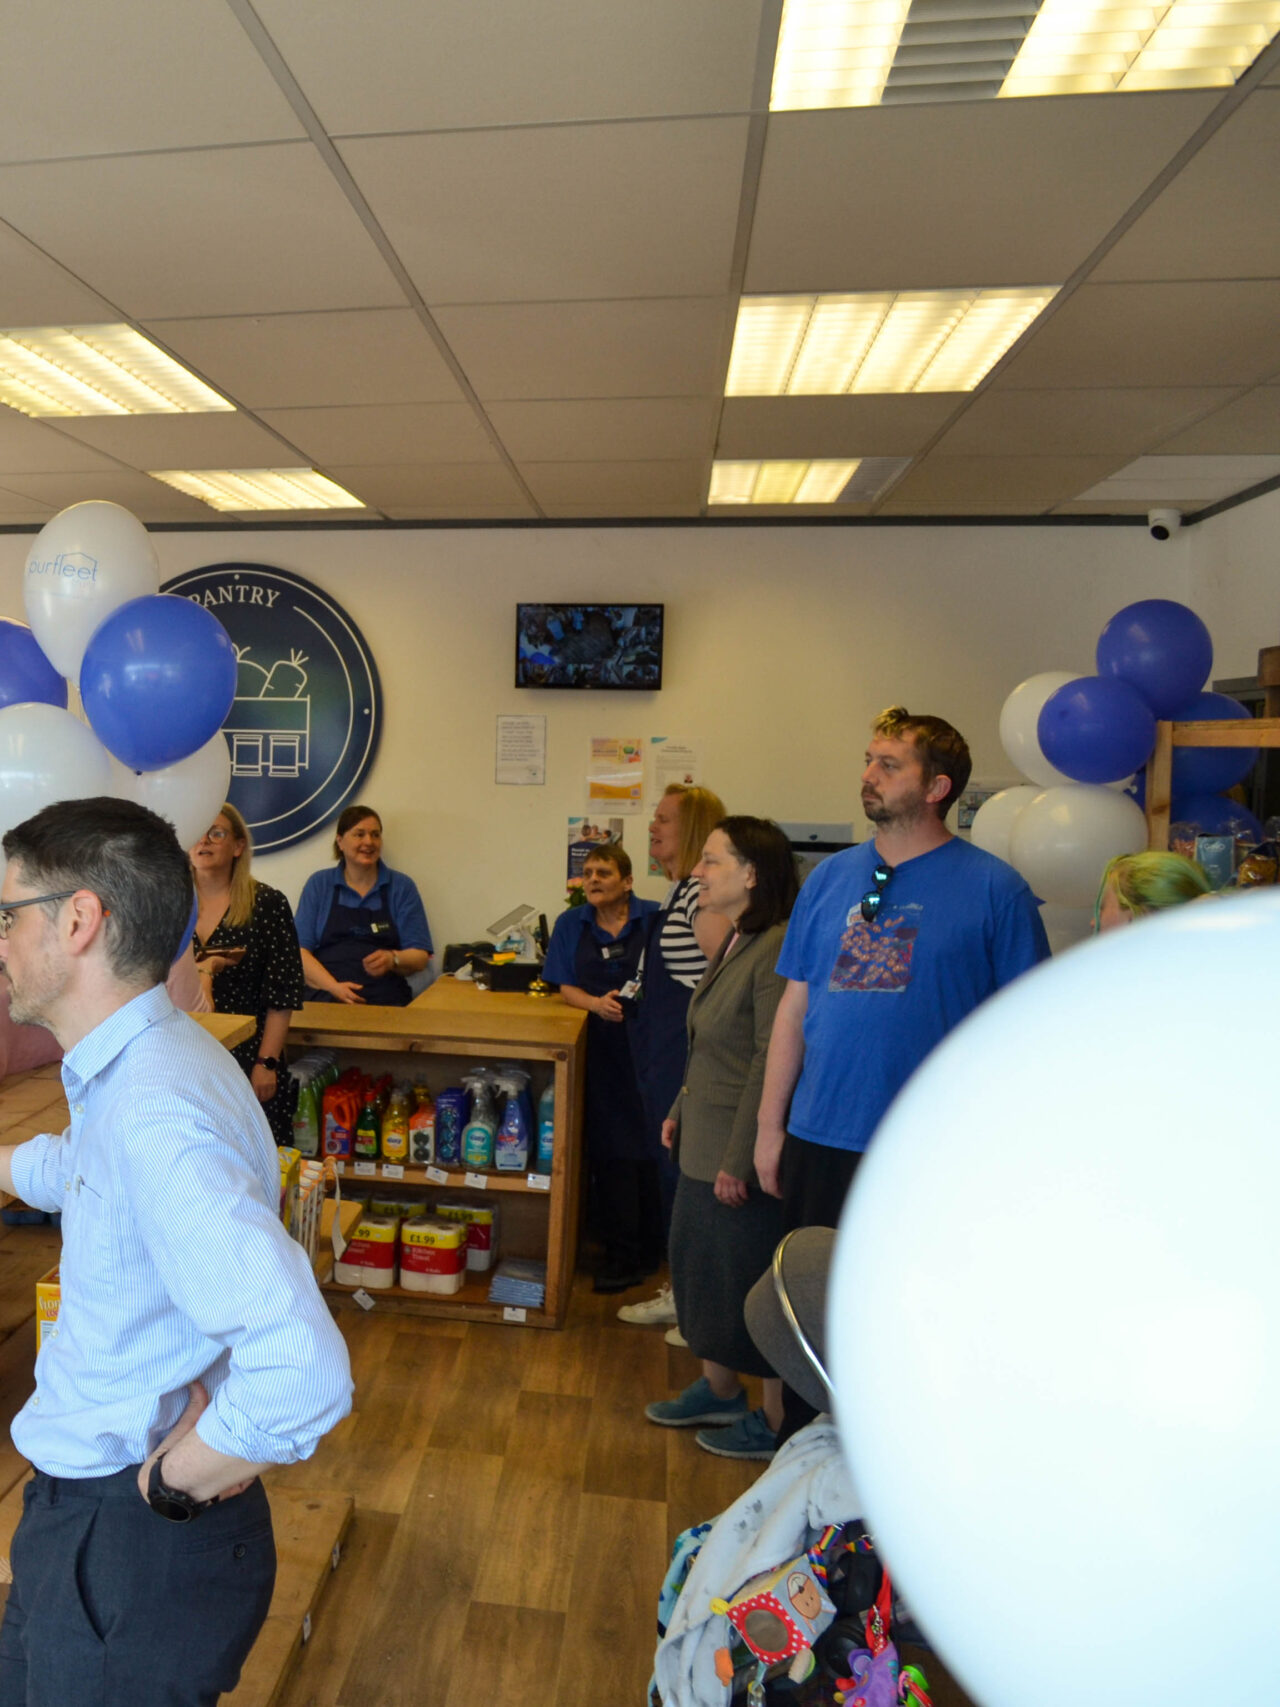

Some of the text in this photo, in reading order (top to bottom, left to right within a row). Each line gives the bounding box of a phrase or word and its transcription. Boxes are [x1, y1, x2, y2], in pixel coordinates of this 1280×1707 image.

[28, 553, 98, 582] purfleet
[188, 584, 281, 609] PANTRY
[410, 1234, 435, 1245] £1.99
